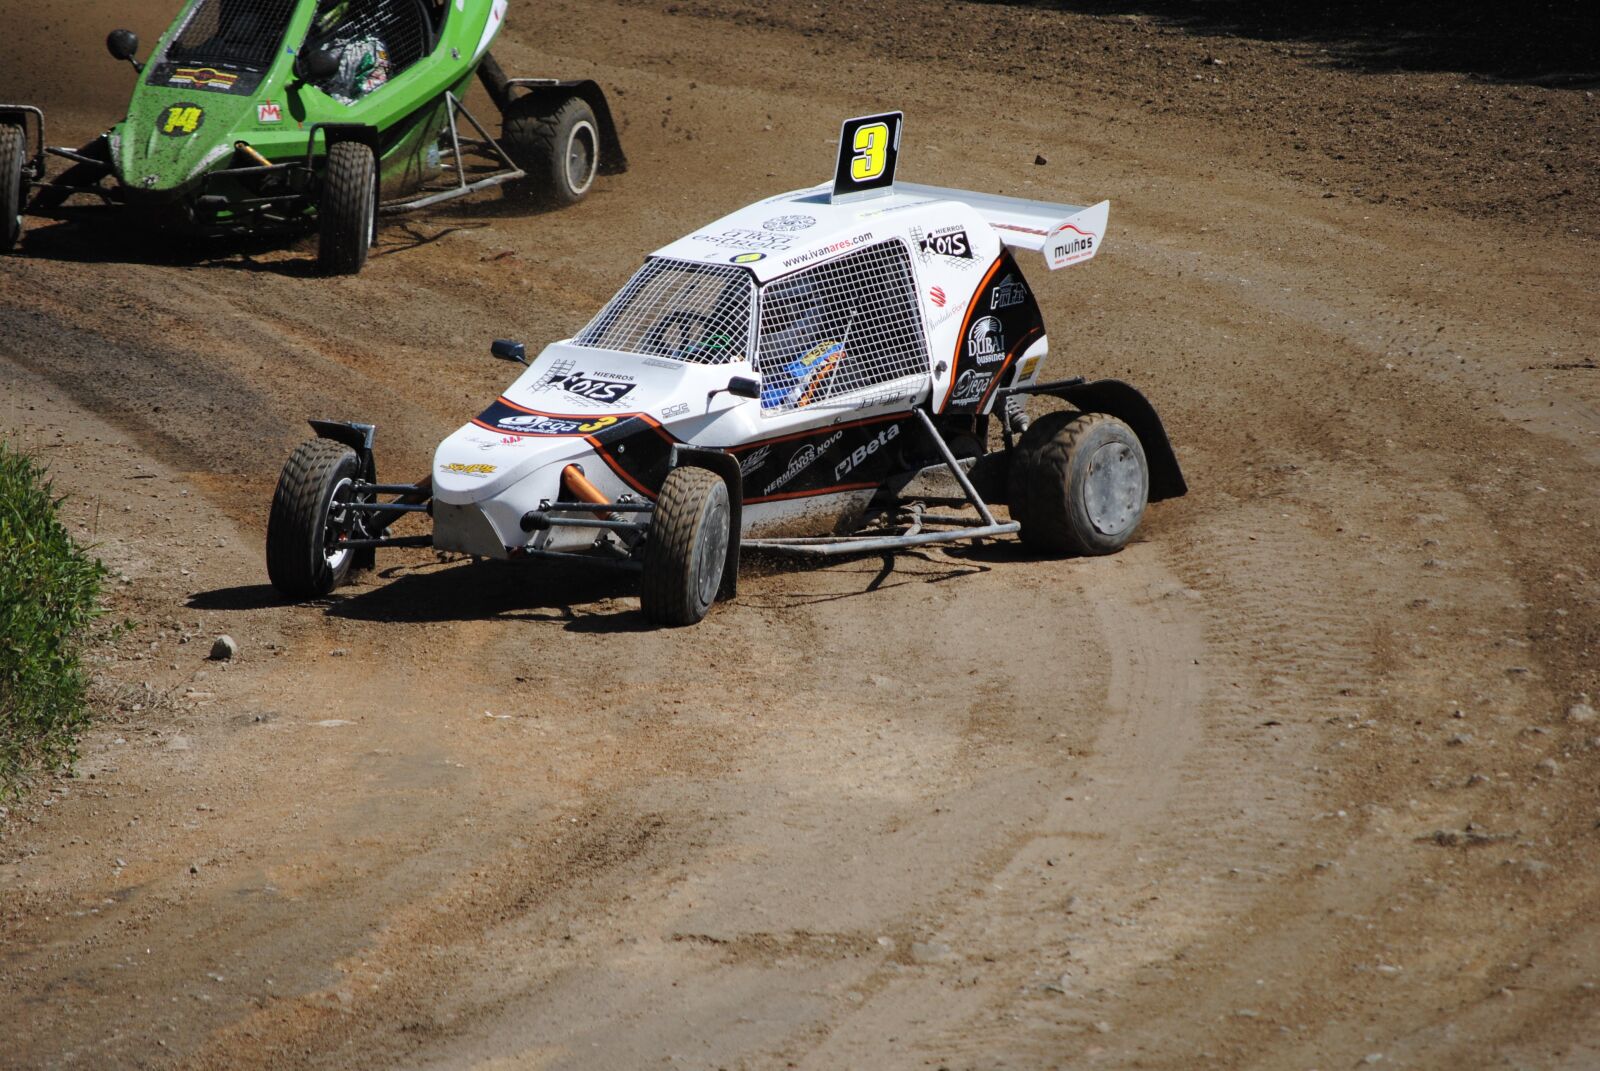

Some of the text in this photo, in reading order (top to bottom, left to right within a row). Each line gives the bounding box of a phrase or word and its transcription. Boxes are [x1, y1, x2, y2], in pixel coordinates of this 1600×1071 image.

[163, 107, 202, 133] 14
[851, 122, 889, 182] 3
[935, 225, 965, 234] HIERROS
[782, 231, 874, 268] www.ivanares.com
[967, 335, 1005, 357] DUBAI
[593, 371, 634, 381] HIERROS
[578, 416, 618, 432] 3
[851, 423, 900, 467] Beta
[763, 452, 816, 495] HERMANOS
[817, 430, 843, 454] NOVO
